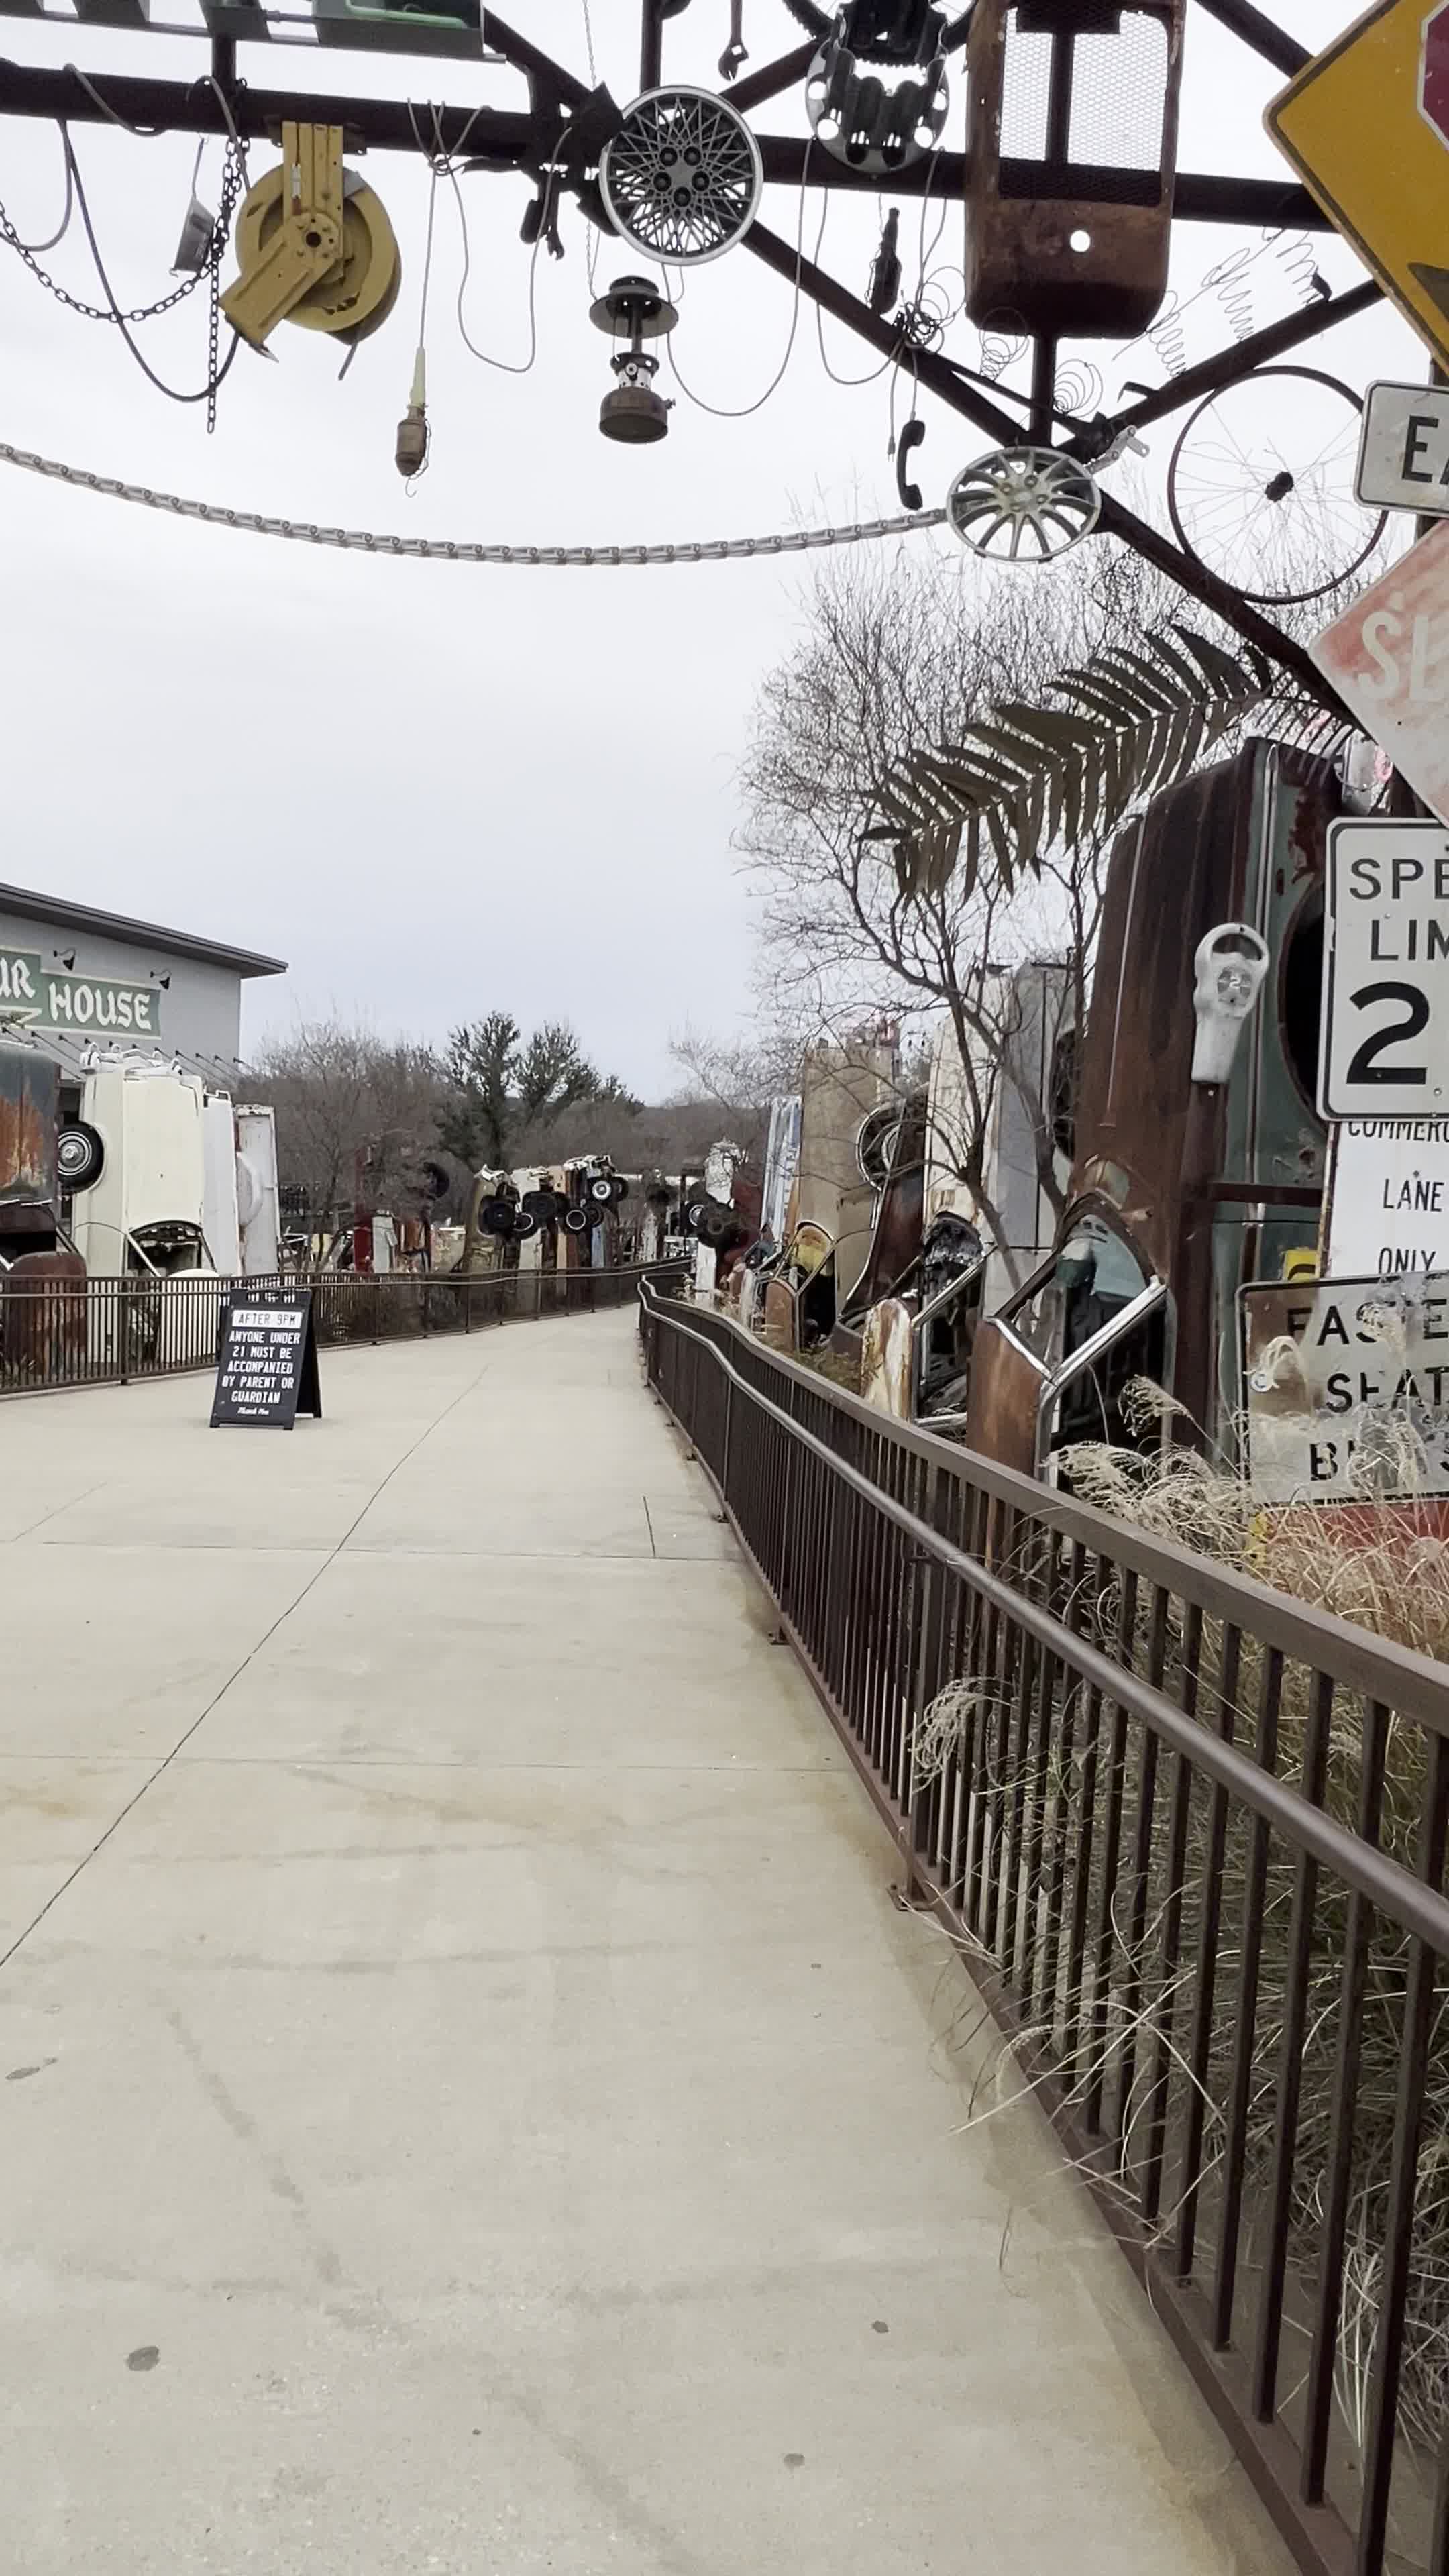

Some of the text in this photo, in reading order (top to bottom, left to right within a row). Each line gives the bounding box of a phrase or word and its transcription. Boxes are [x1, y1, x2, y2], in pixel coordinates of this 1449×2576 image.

[1402, 415, 1449, 484] E
[1350, 858, 1449, 900] SPE
[1371, 919, 1449, 961] LIM
[48, 981, 152, 1031] HOUSE
[1346, 981, 1430, 1085] 2
[1348, 1121, 1449, 1143] COMMER
[1383, 1178, 1444, 1212] LANE
[237, 1313, 296, 1326] AFTER 9PM
[1287, 1299, 1448, 1346] FASE
[228, 1330, 301, 1344] ANYONE UNDER
[233, 1346, 292, 1359] 21 MUST BE
[227, 1361, 293, 1374] ACCOMPANIED
[222, 1375, 294, 1389] BY PARENT OR
[231, 1391, 280, 1404] GUARDIAN
